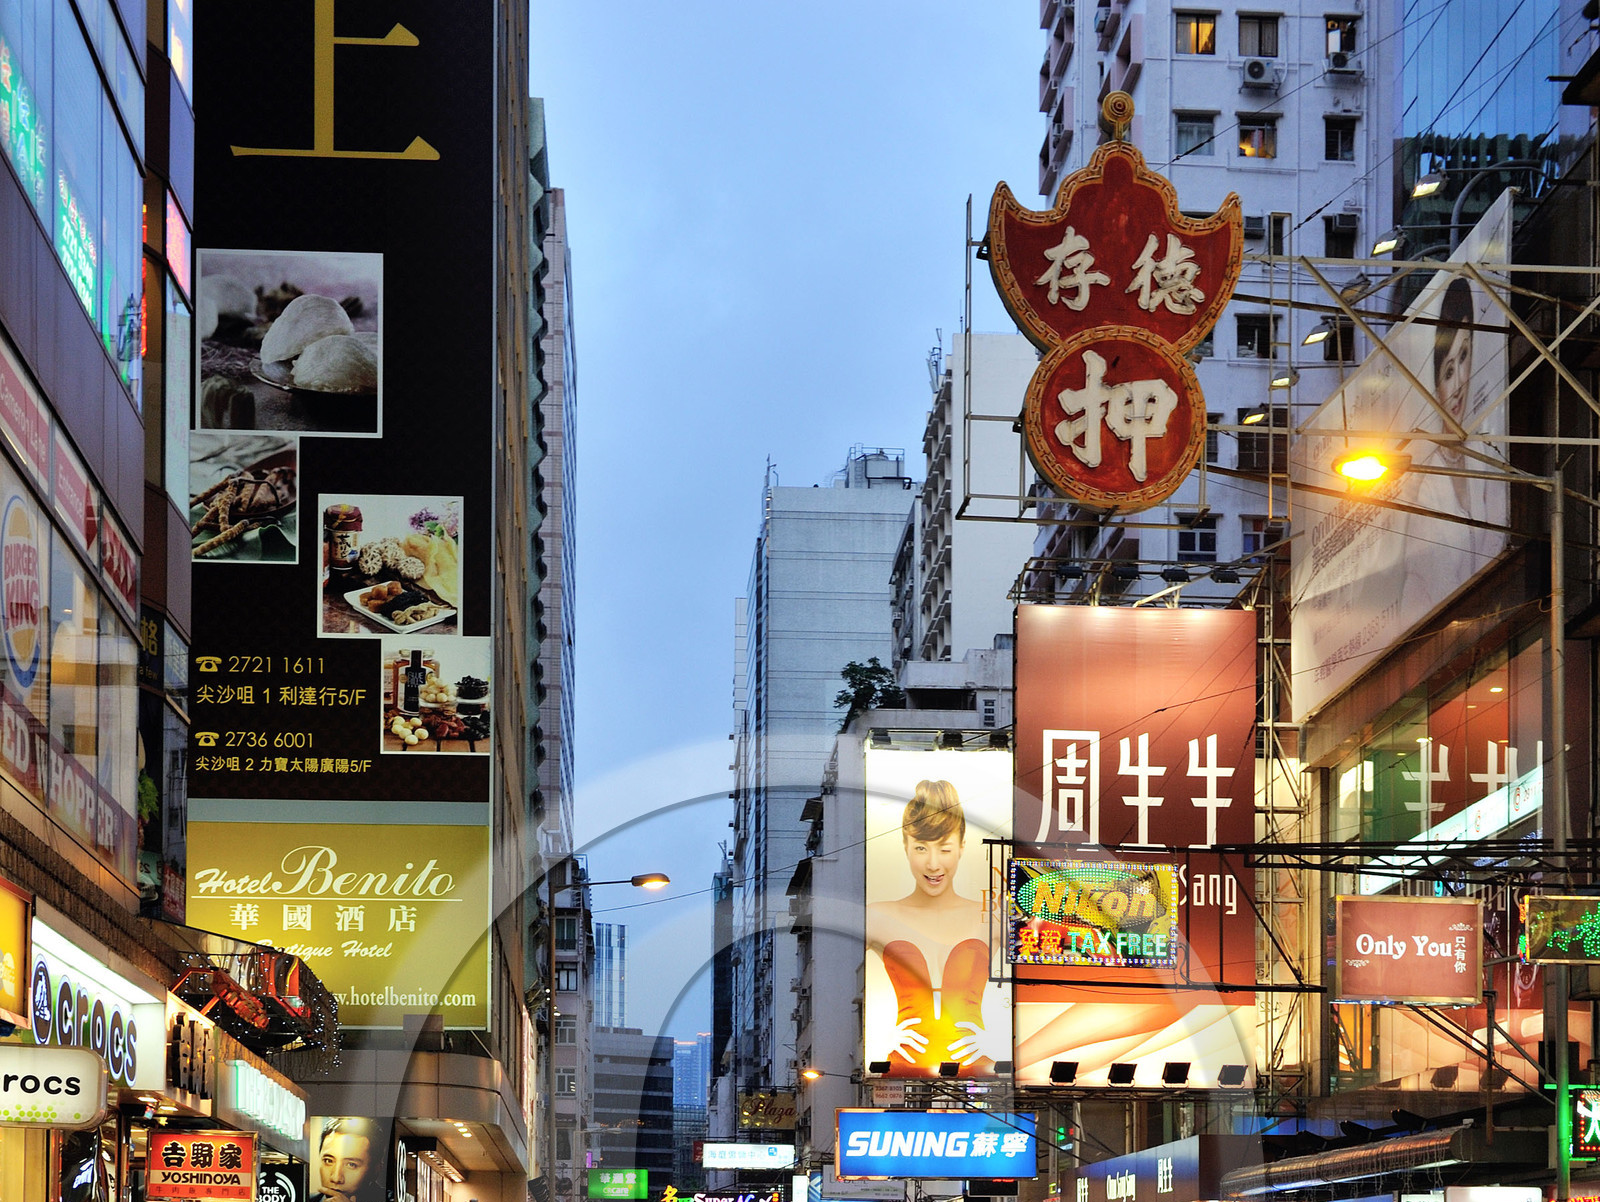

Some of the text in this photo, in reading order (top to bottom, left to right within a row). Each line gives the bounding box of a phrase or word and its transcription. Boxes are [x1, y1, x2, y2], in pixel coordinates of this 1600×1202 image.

[1, 372, 46, 462] Cameron Lane
[1057, 349, 1178, 483] 押
[58, 464, 85, 517] Entrance
[4, 543, 39, 581] BURGER
[5, 577, 40, 631] KING
[228, 656, 325, 674] 2721 1611
[196, 685, 256, 705] 尖沙咀
[263, 688, 271, 704] 1
[225, 731, 314, 748] 2736 6001
[195, 756, 241, 772] 尖沙咀
[246, 758, 254, 771] 2
[35, 733, 115, 849] WHOPPER
[1034, 729, 1237, 853] 周生生
[194, 867, 273, 895] Hotel
[271, 845, 455, 896] Benito
[1031, 880, 1158, 920] Nikon
[1179, 864, 1238, 915] Sang
[229, 903, 417, 932] 華國酒店
[341, 940, 392, 958] Hotel
[1068, 931, 1168, 957] TAX FREE
[1355, 933, 1452, 960] Only You
[1453, 936, 1467, 974] 只有你
[56, 974, 138, 1088] crocs
[3, 1073, 82, 1096] rocs
[743, 1098, 796, 1124] Plaza
[161, 1141, 242, 1169] 吉野家
[846, 1131, 970, 1158] SUNING
[970, 1132, 1029, 1158] 蘇寧
[161, 1171, 241, 1185] YOSHINOYA
[262, 1186, 280, 1195] THE
